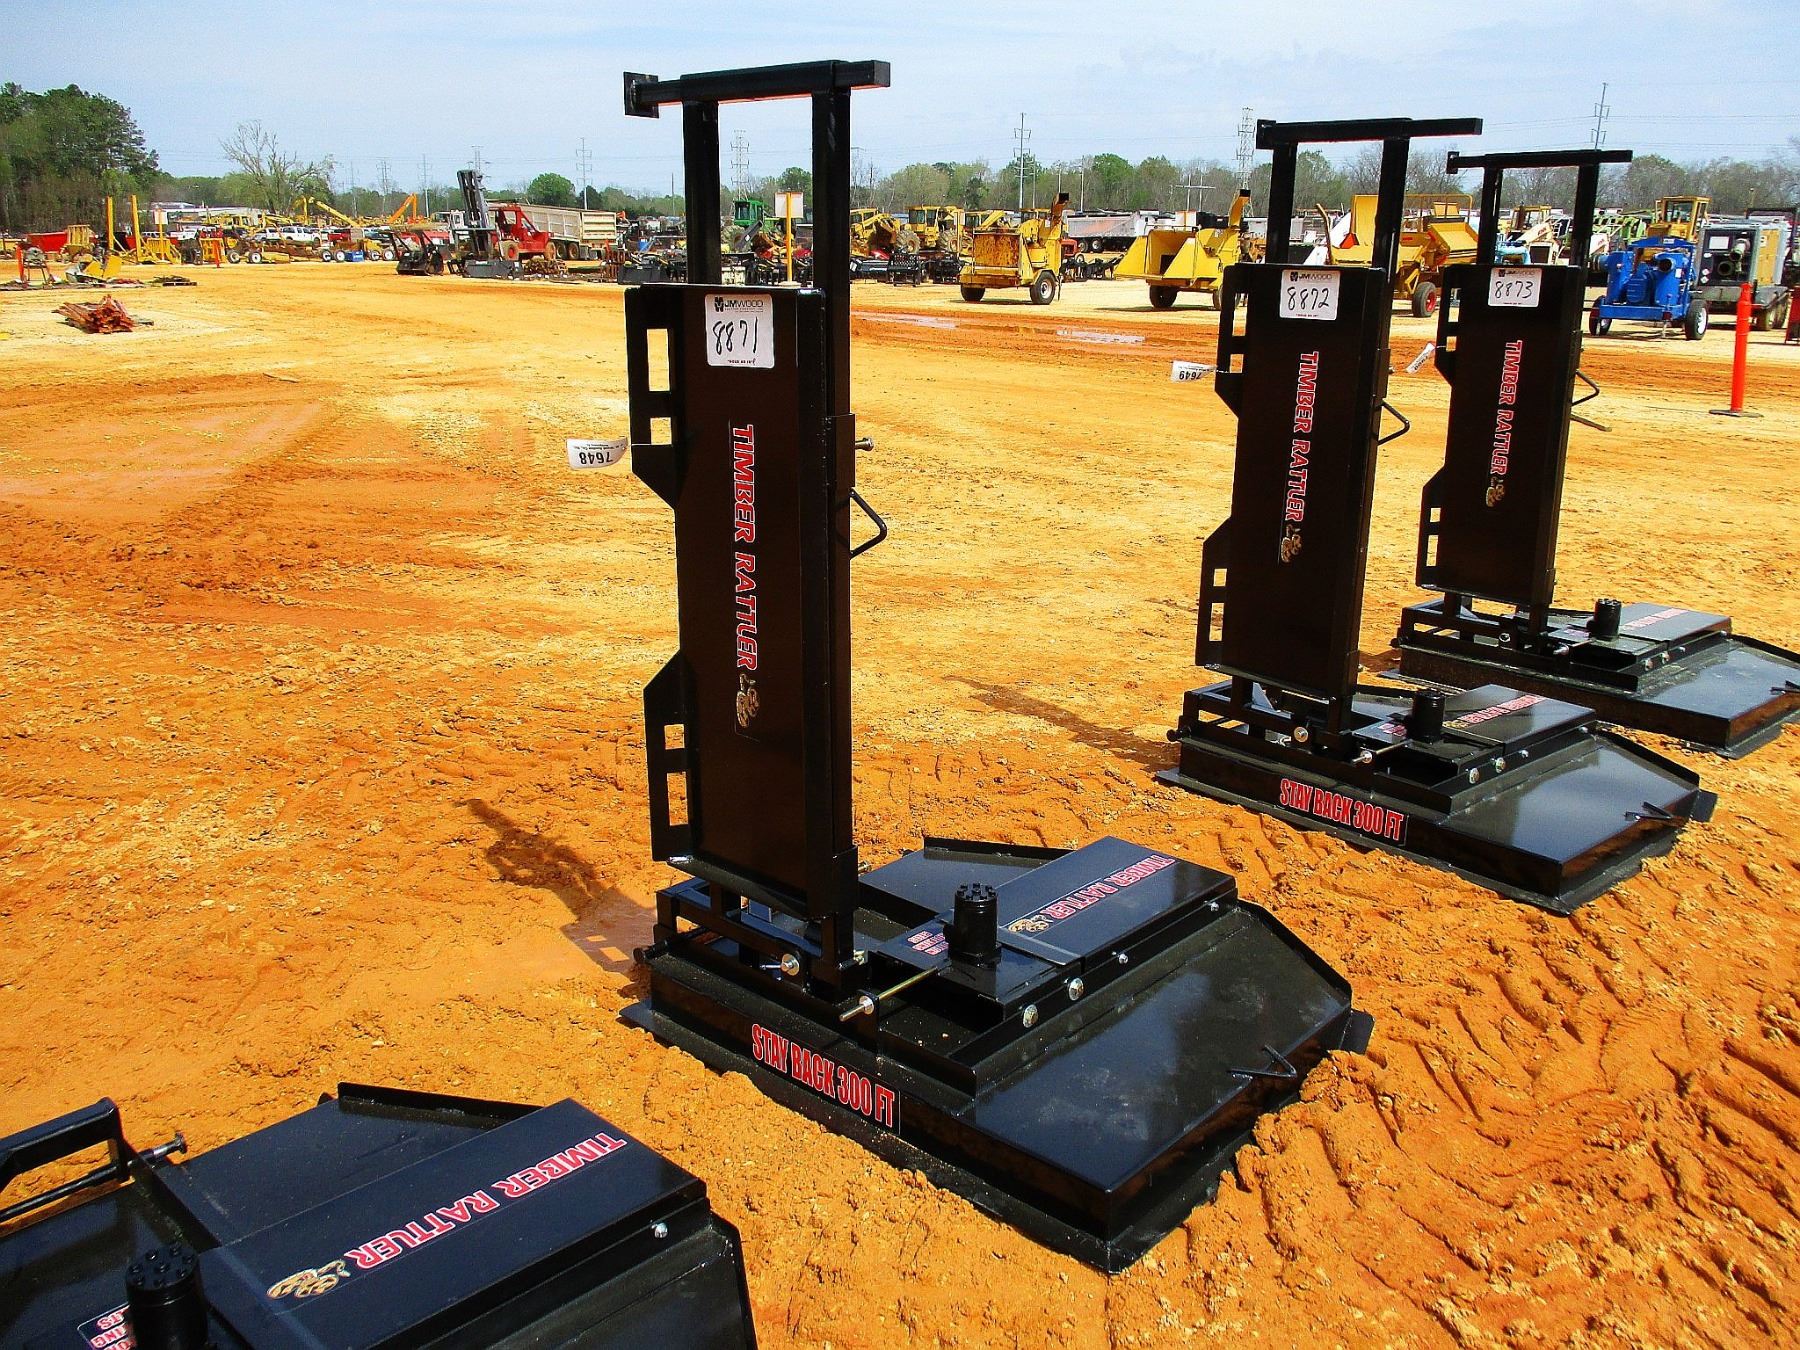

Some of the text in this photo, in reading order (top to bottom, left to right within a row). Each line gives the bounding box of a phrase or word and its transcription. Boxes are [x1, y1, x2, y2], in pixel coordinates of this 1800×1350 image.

[1287, 286, 1330, 311] 8872
[1494, 281, 1533, 299] 8873
[712, 315, 758, 356] 8871
[1179, 370, 1202, 380] 7649
[1490, 339, 1522, 475] TIMBER RATTLER
[578, 451, 614, 465] 7648
[1285, 351, 1319, 522] TIMBER RATTLER
[732, 423, 757, 671] TIMBER RATTLER
[1279, 778, 1404, 841] STAY BACK 300 FT
[1039, 854, 1176, 919] TIMBER RATTLER
[751, 1023, 895, 1128] STAY BACK 300 FT
[344, 1132, 628, 1270] TIMBER RATTLER
